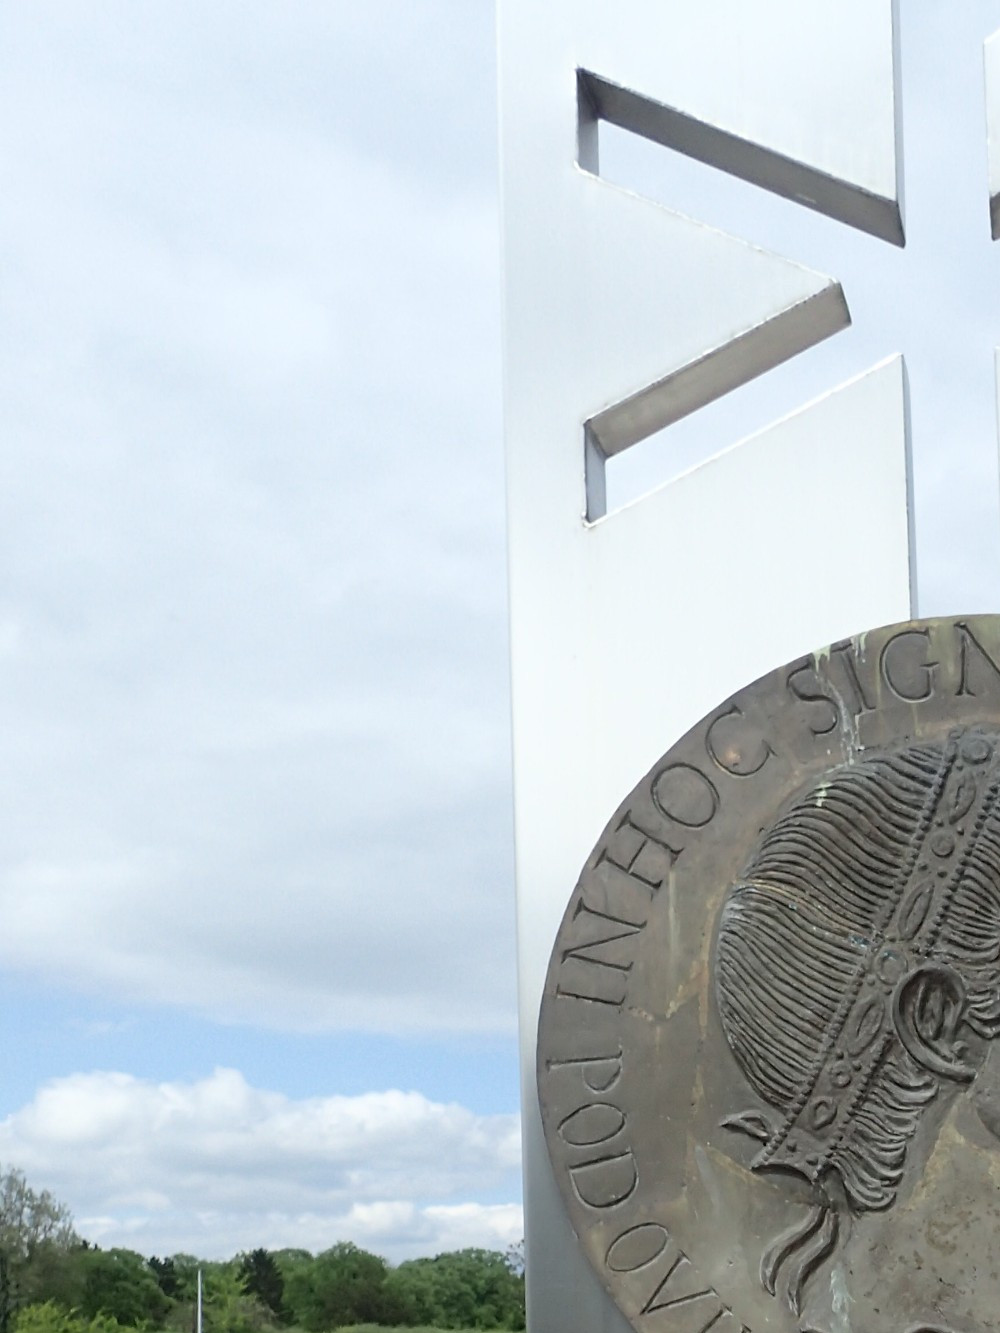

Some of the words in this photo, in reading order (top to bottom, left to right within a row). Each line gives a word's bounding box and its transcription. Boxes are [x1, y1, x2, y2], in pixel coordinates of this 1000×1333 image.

[592, 704, 777, 894] HOC
[556, 896, 648, 1007] IN
[546, 1046, 640, 1209] POD
